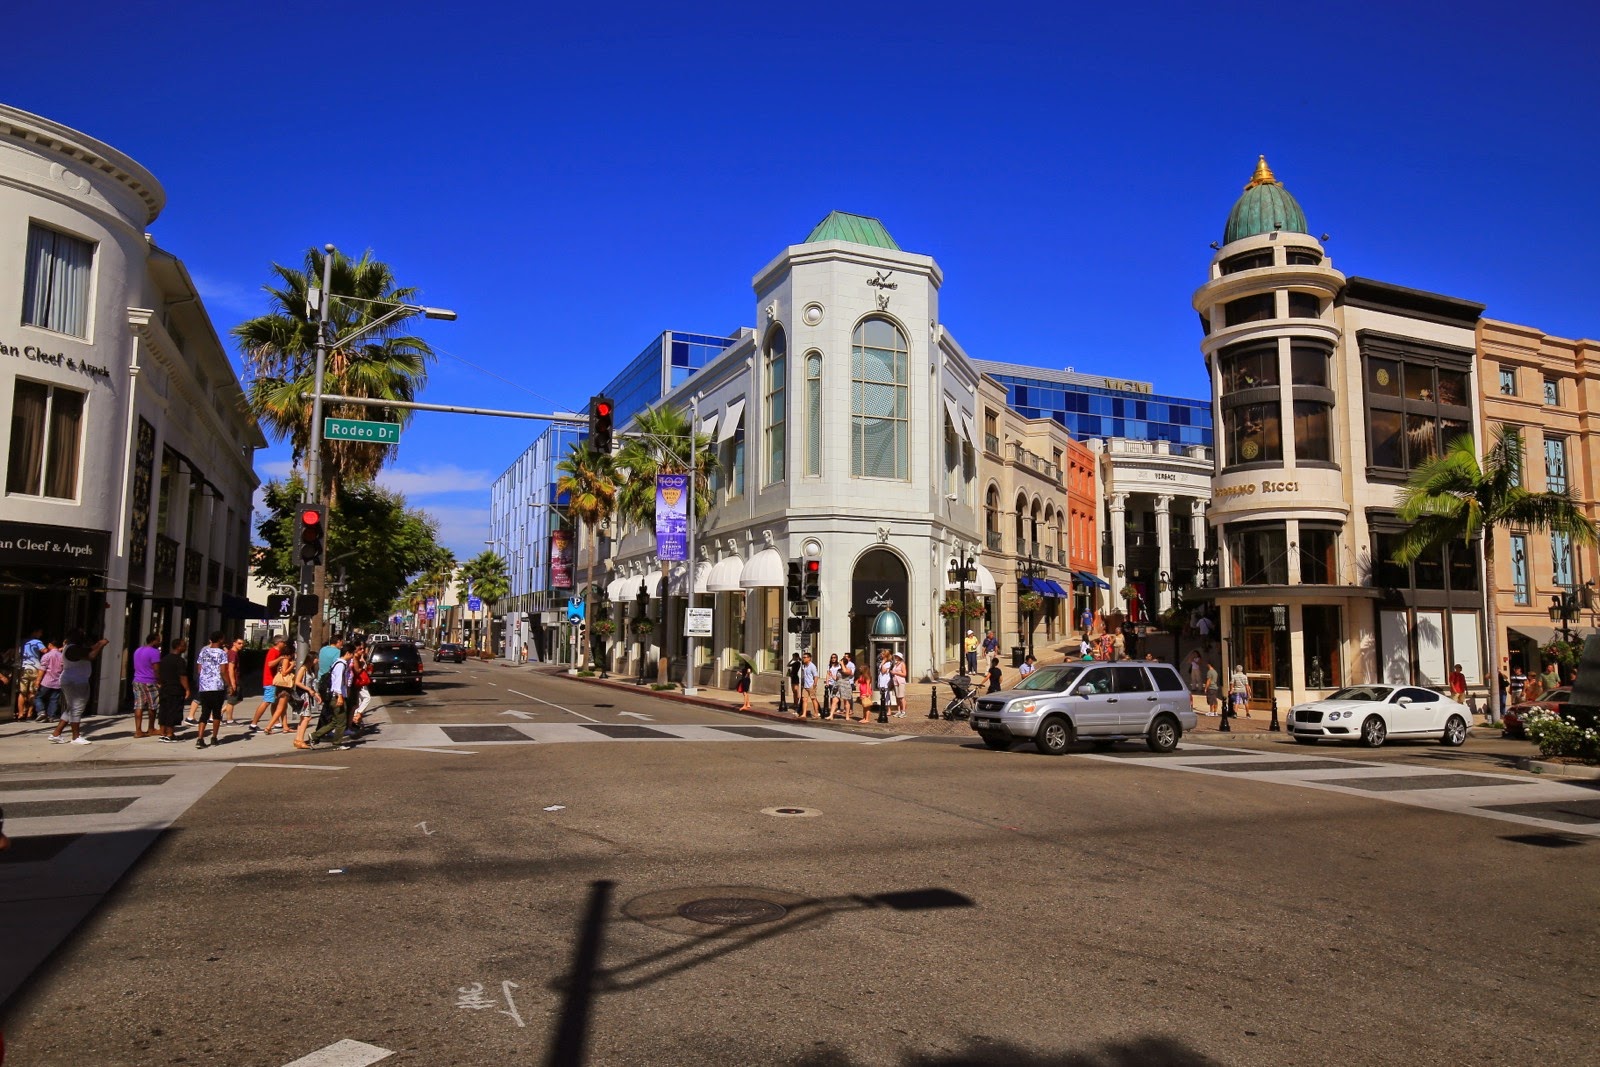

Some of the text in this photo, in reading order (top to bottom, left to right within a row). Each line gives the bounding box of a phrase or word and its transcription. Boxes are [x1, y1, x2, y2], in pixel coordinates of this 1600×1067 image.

[0, 342, 19, 357] an
[24, 346, 64, 367] Cleef
[66, 358, 75, 370] &
[331, 423, 394, 438] Rodeo Dr
[1262, 480, 1299, 493] RICCI
[0, 538, 93, 557] an Cleef & Arpels
[69, 577, 88, 587] 300
[574, 597, 581, 606] P
